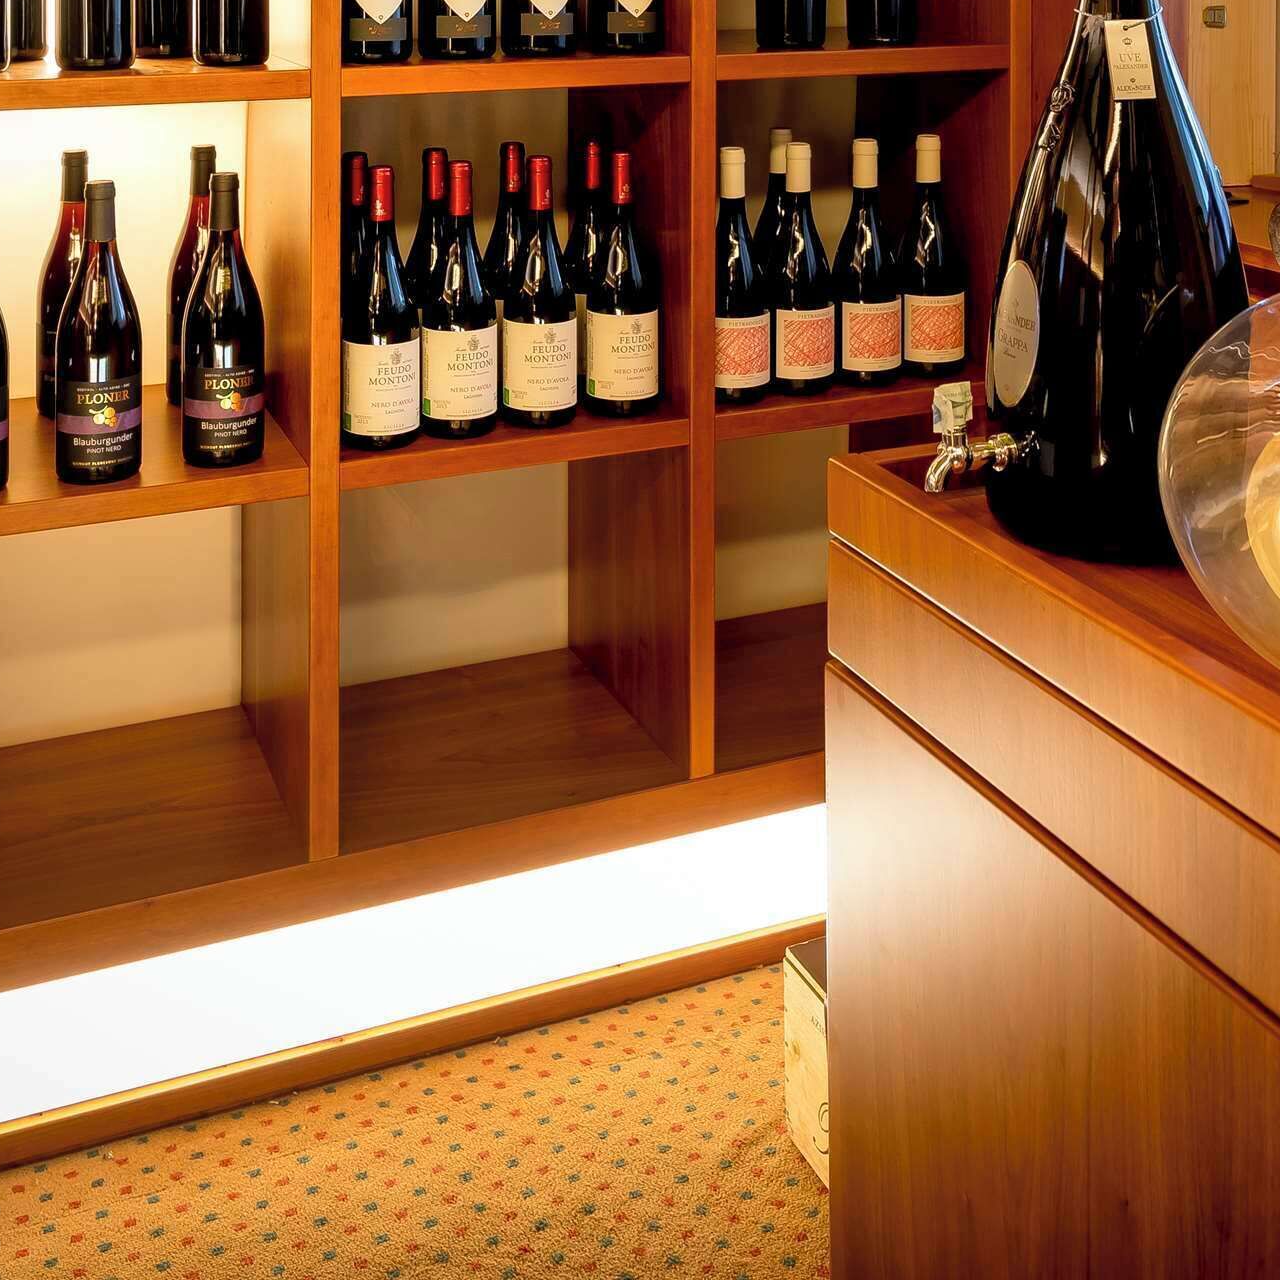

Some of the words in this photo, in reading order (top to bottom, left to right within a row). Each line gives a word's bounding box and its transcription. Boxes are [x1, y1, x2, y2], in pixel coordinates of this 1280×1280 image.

[1119, 52, 1142, 63] UVE
[619, 334, 650, 344] FEUDO
[997, 328, 1028, 353] GRAPPA
[532, 343, 566, 354] FEUDO
[611, 342, 655, 354] MONTONI
[455, 350, 489, 362] FEUDO
[524, 352, 571, 363] MONTONI
[377, 364, 411, 376] FEUDO
[447, 358, 494, 372] MONTONI
[633, 365, 654, 373] D'AVOLA
[204, 375, 254, 390] PLONER
[368, 371, 416, 386] MONTONI
[547, 376, 569, 384] D'AVOLA
[470, 383, 492, 391] D'AVOLA
[76, 389, 130, 405] PLONER
[392, 397, 415, 406] D'AVOLA
[201, 417, 257, 430] Blauburgunder
[73, 432, 133, 448] Blauburgunder
[86, 446, 104, 454] PINOT
[105, 445, 122, 453] NERO
